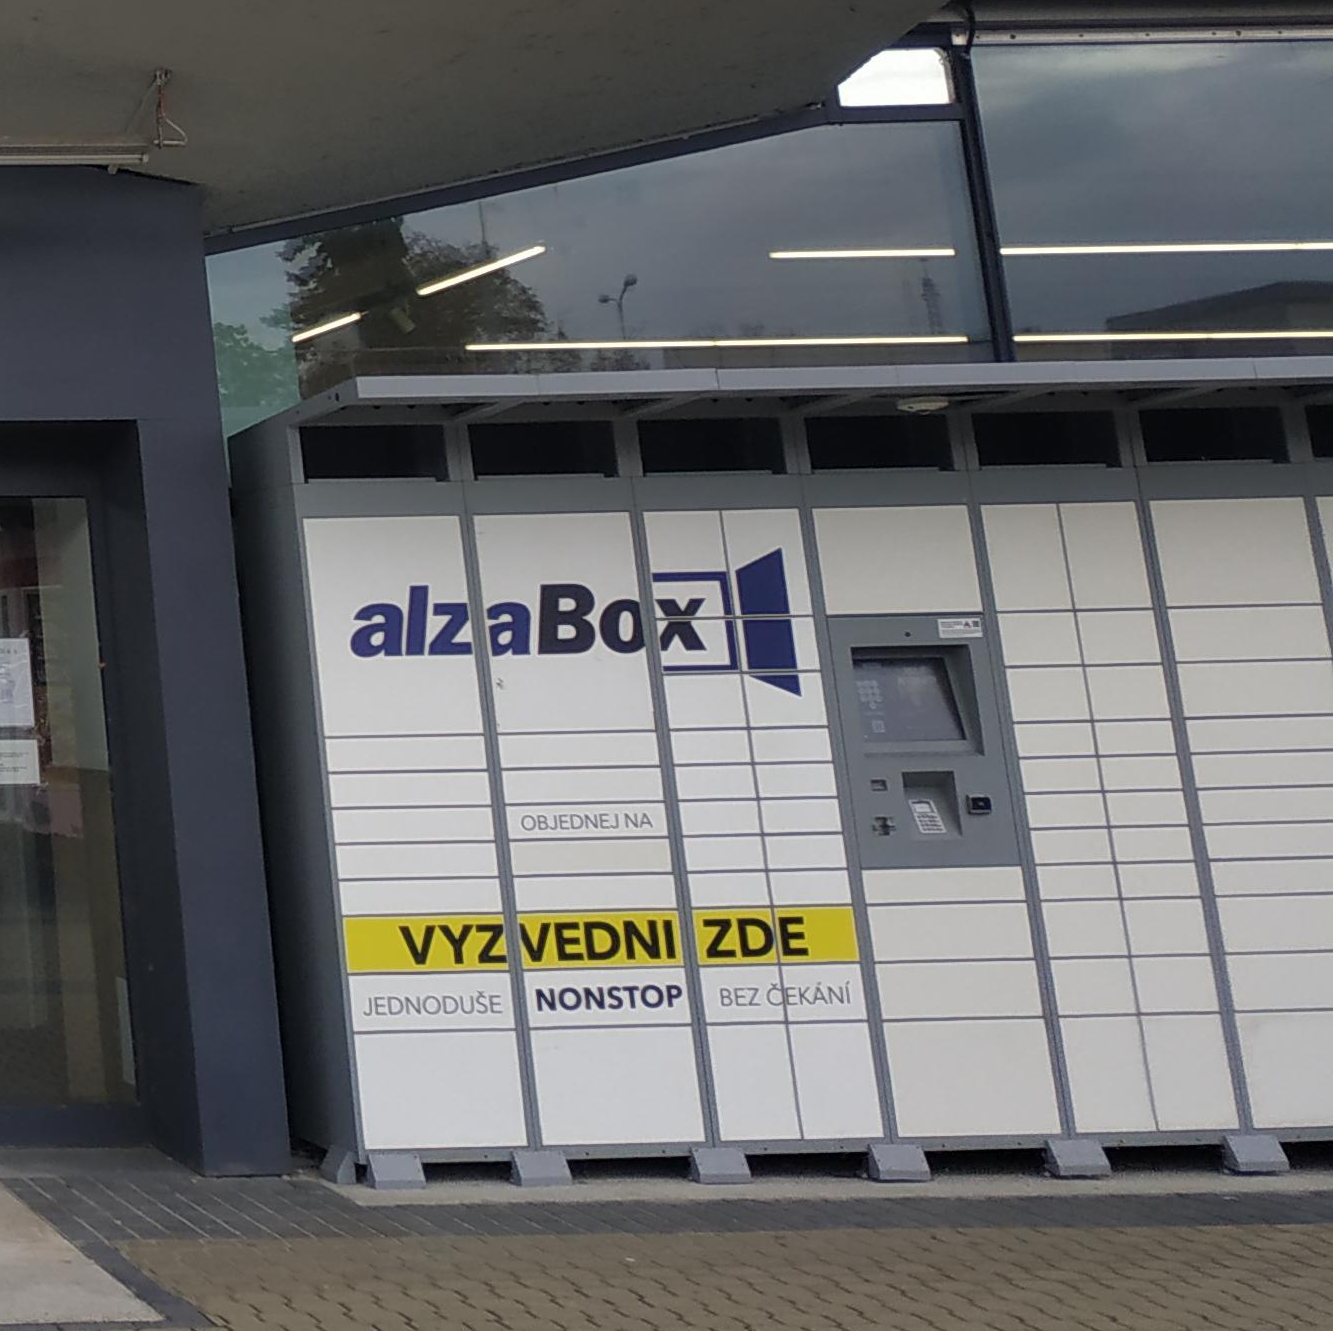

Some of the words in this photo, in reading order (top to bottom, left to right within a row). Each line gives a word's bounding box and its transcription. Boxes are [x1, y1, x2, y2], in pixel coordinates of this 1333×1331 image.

[349, 582, 707, 658] alzaBox
[520, 813, 620, 832] OBJEDNEJ
[624, 812, 654, 830] NA
[398, 919, 677, 965] VYZVEDNI
[702, 916, 809, 959] ZDE
[362, 989, 504, 1017] JEDNODUŠE
[535, 983, 683, 1012] NONSTOP
[719, 986, 760, 1007] BEZ
[767, 979, 852, 1006] ČEKÁNÍ
